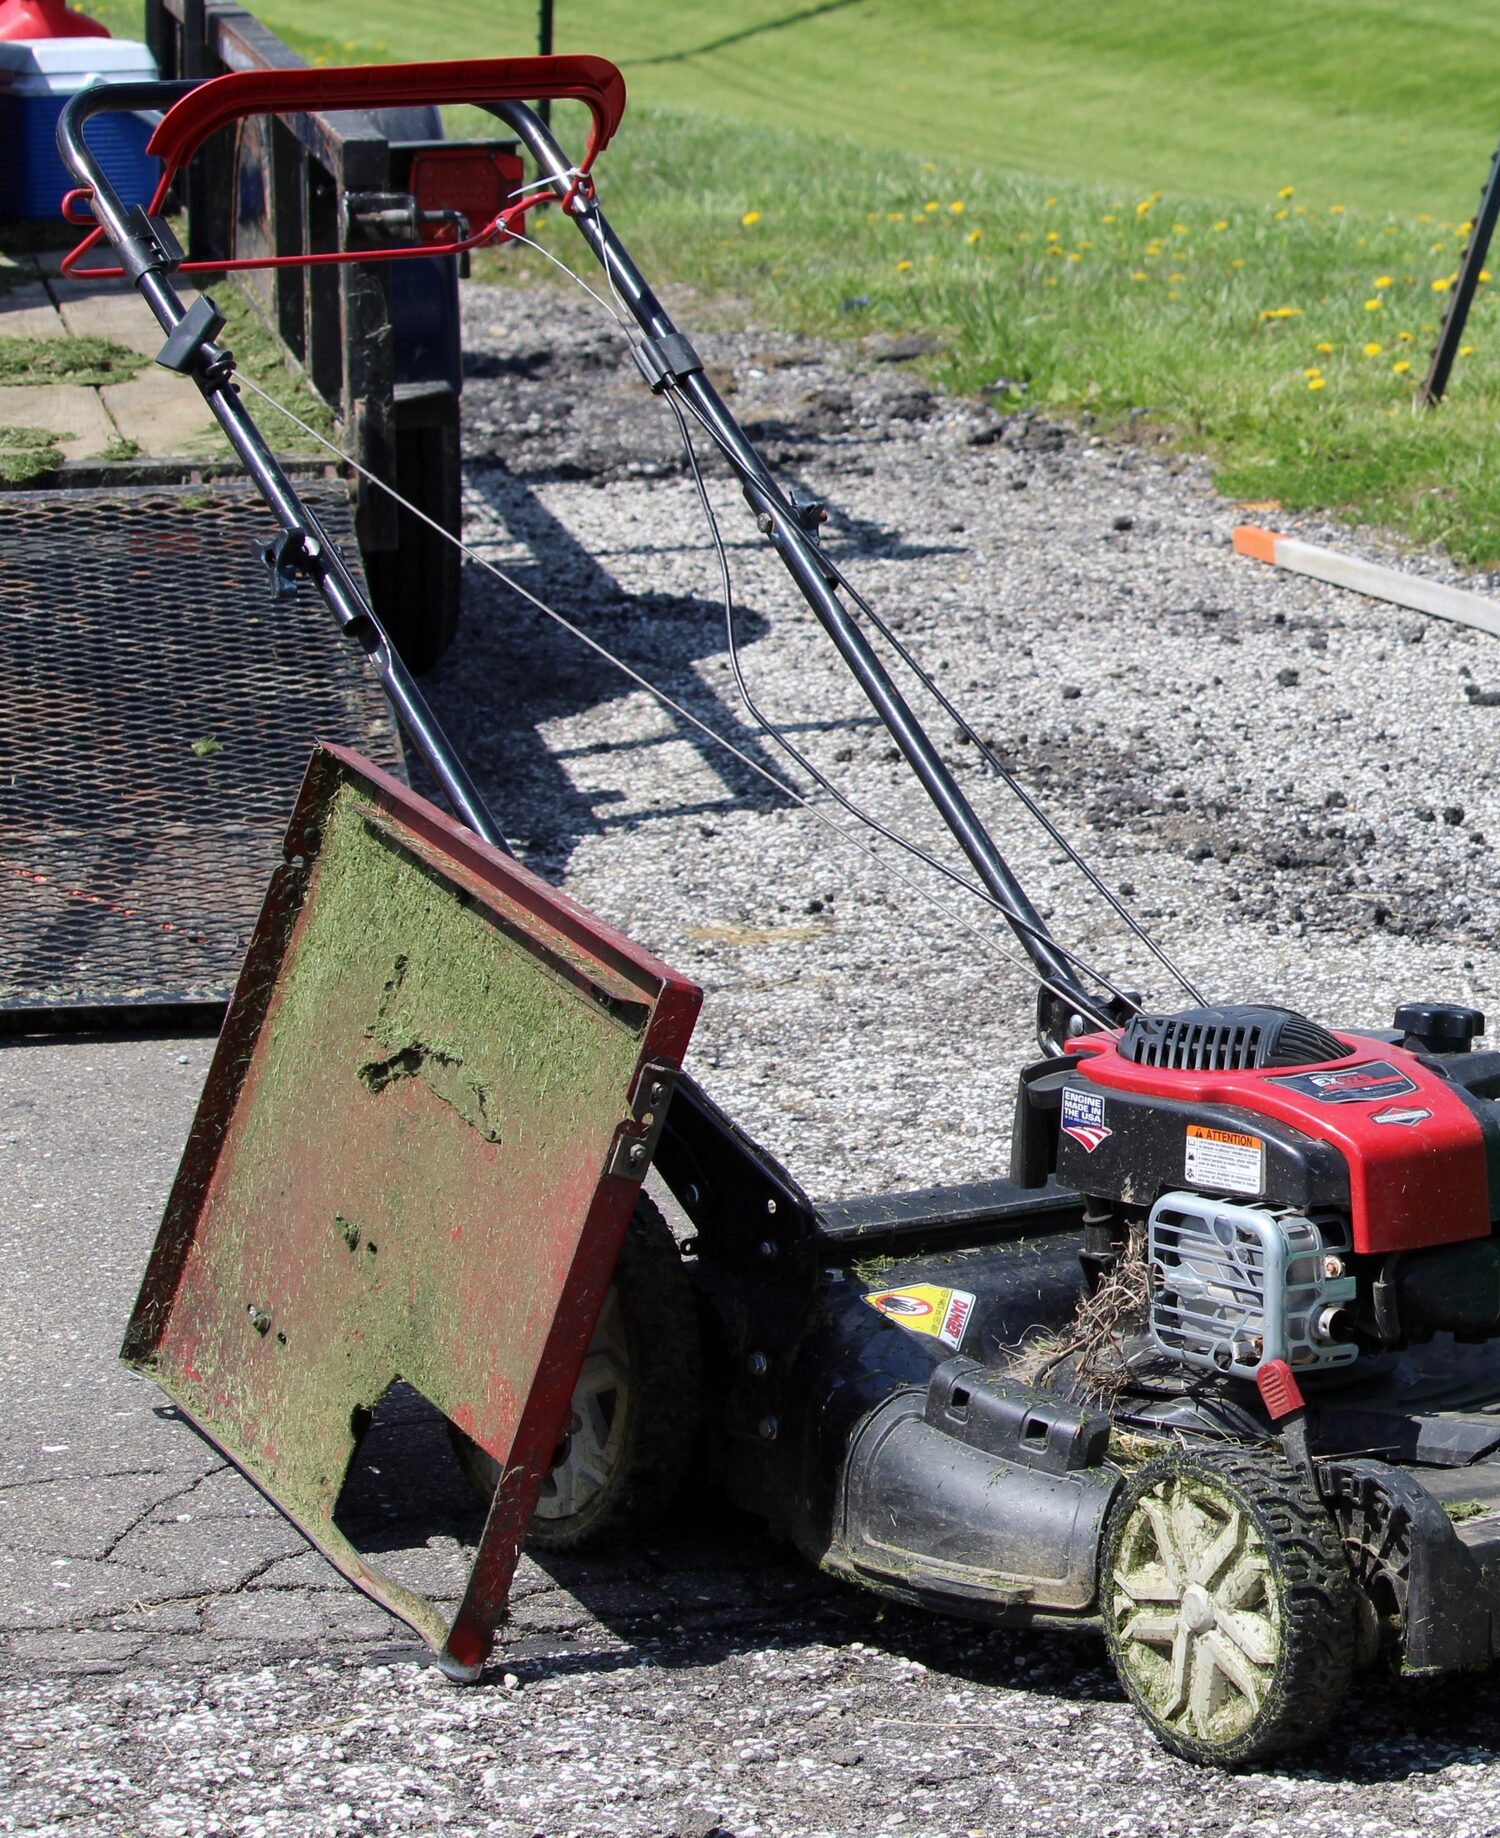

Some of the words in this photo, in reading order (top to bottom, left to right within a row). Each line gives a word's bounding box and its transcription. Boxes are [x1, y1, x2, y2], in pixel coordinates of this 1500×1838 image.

[1065, 1091, 1102, 1107] ENGINE
[1064, 1100, 1089, 1112] MADE
[1091, 1107, 1102, 1116] IN
[1064, 1107, 1080, 1118] THE
[1081, 1111, 1102, 1123] USA
[1206, 1128, 1253, 1148] ATTENTION
[945, 1298, 969, 1339] DANGER
